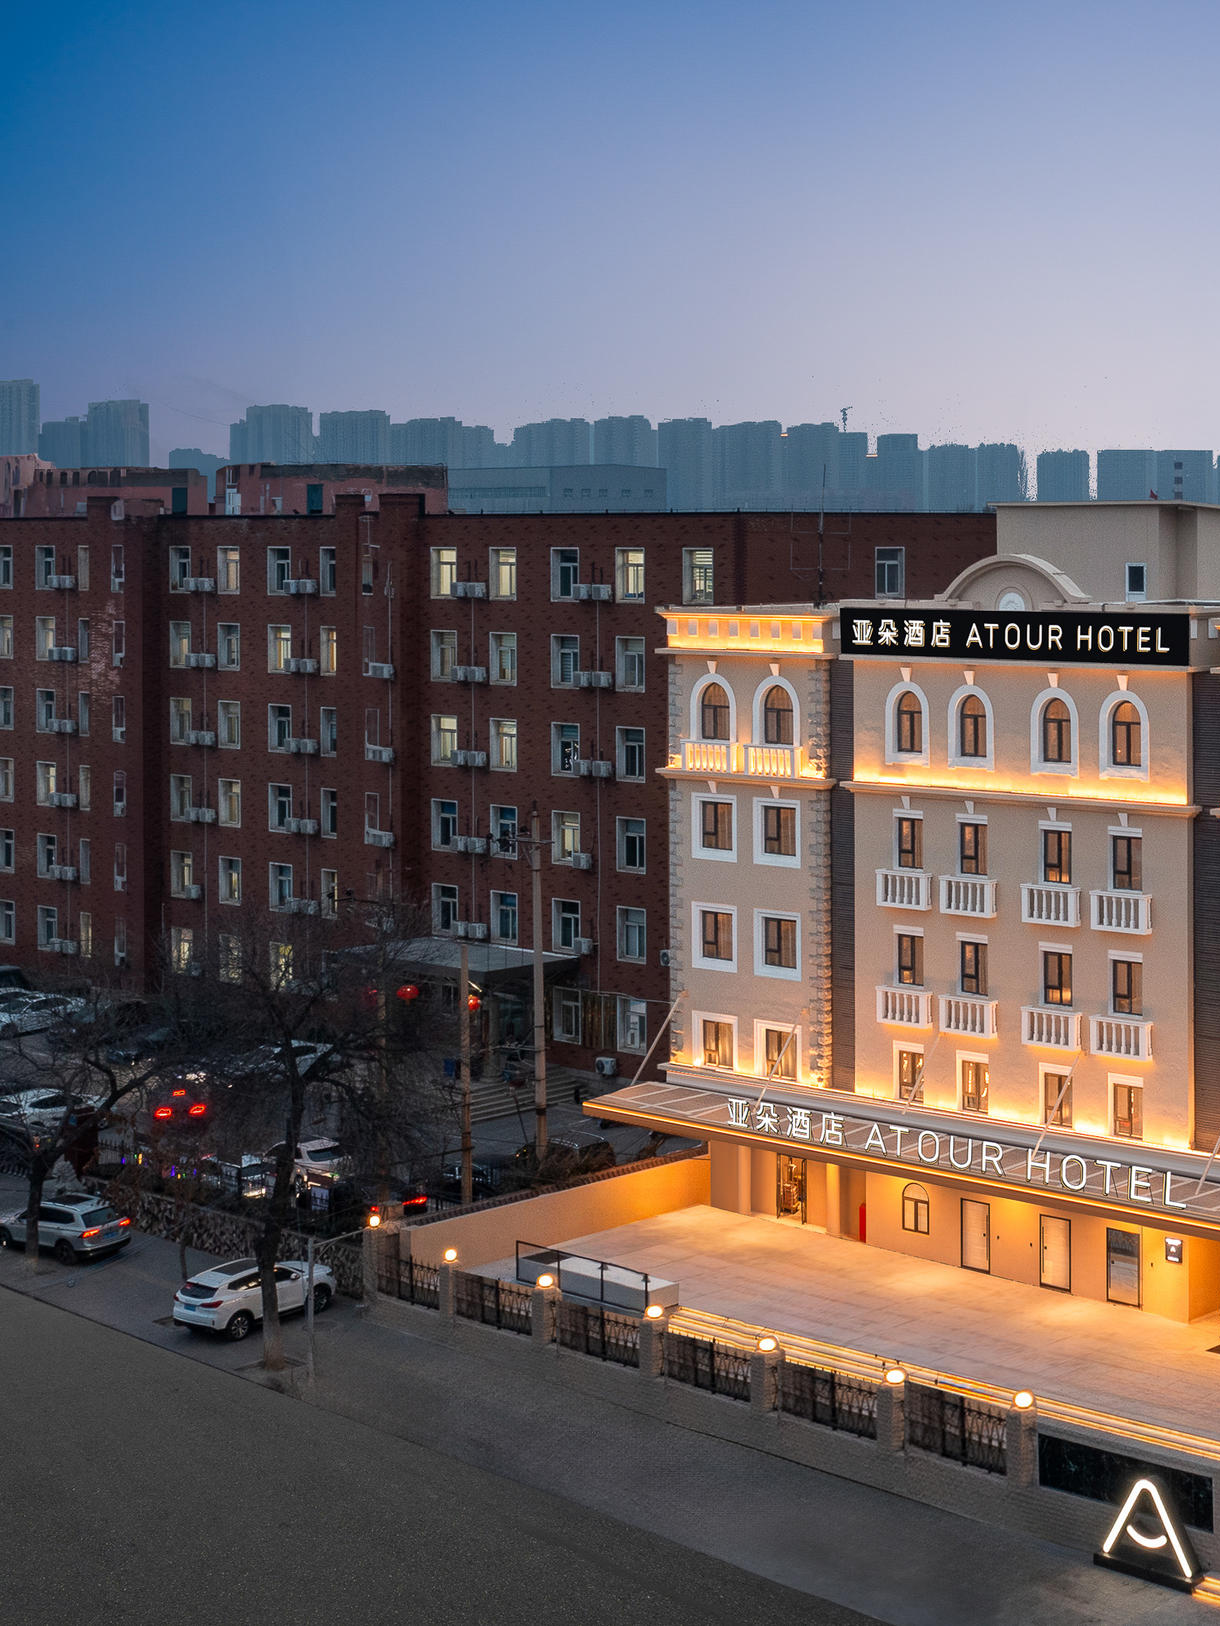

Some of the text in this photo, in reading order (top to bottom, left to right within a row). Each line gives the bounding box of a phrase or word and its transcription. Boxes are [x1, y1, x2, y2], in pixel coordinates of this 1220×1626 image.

[851, 619, 1170, 652] 亚朵酒店 ATOUR HOTEL
[727, 1097, 1187, 1210] 亚朵酒店 ATOUR HOTEL
